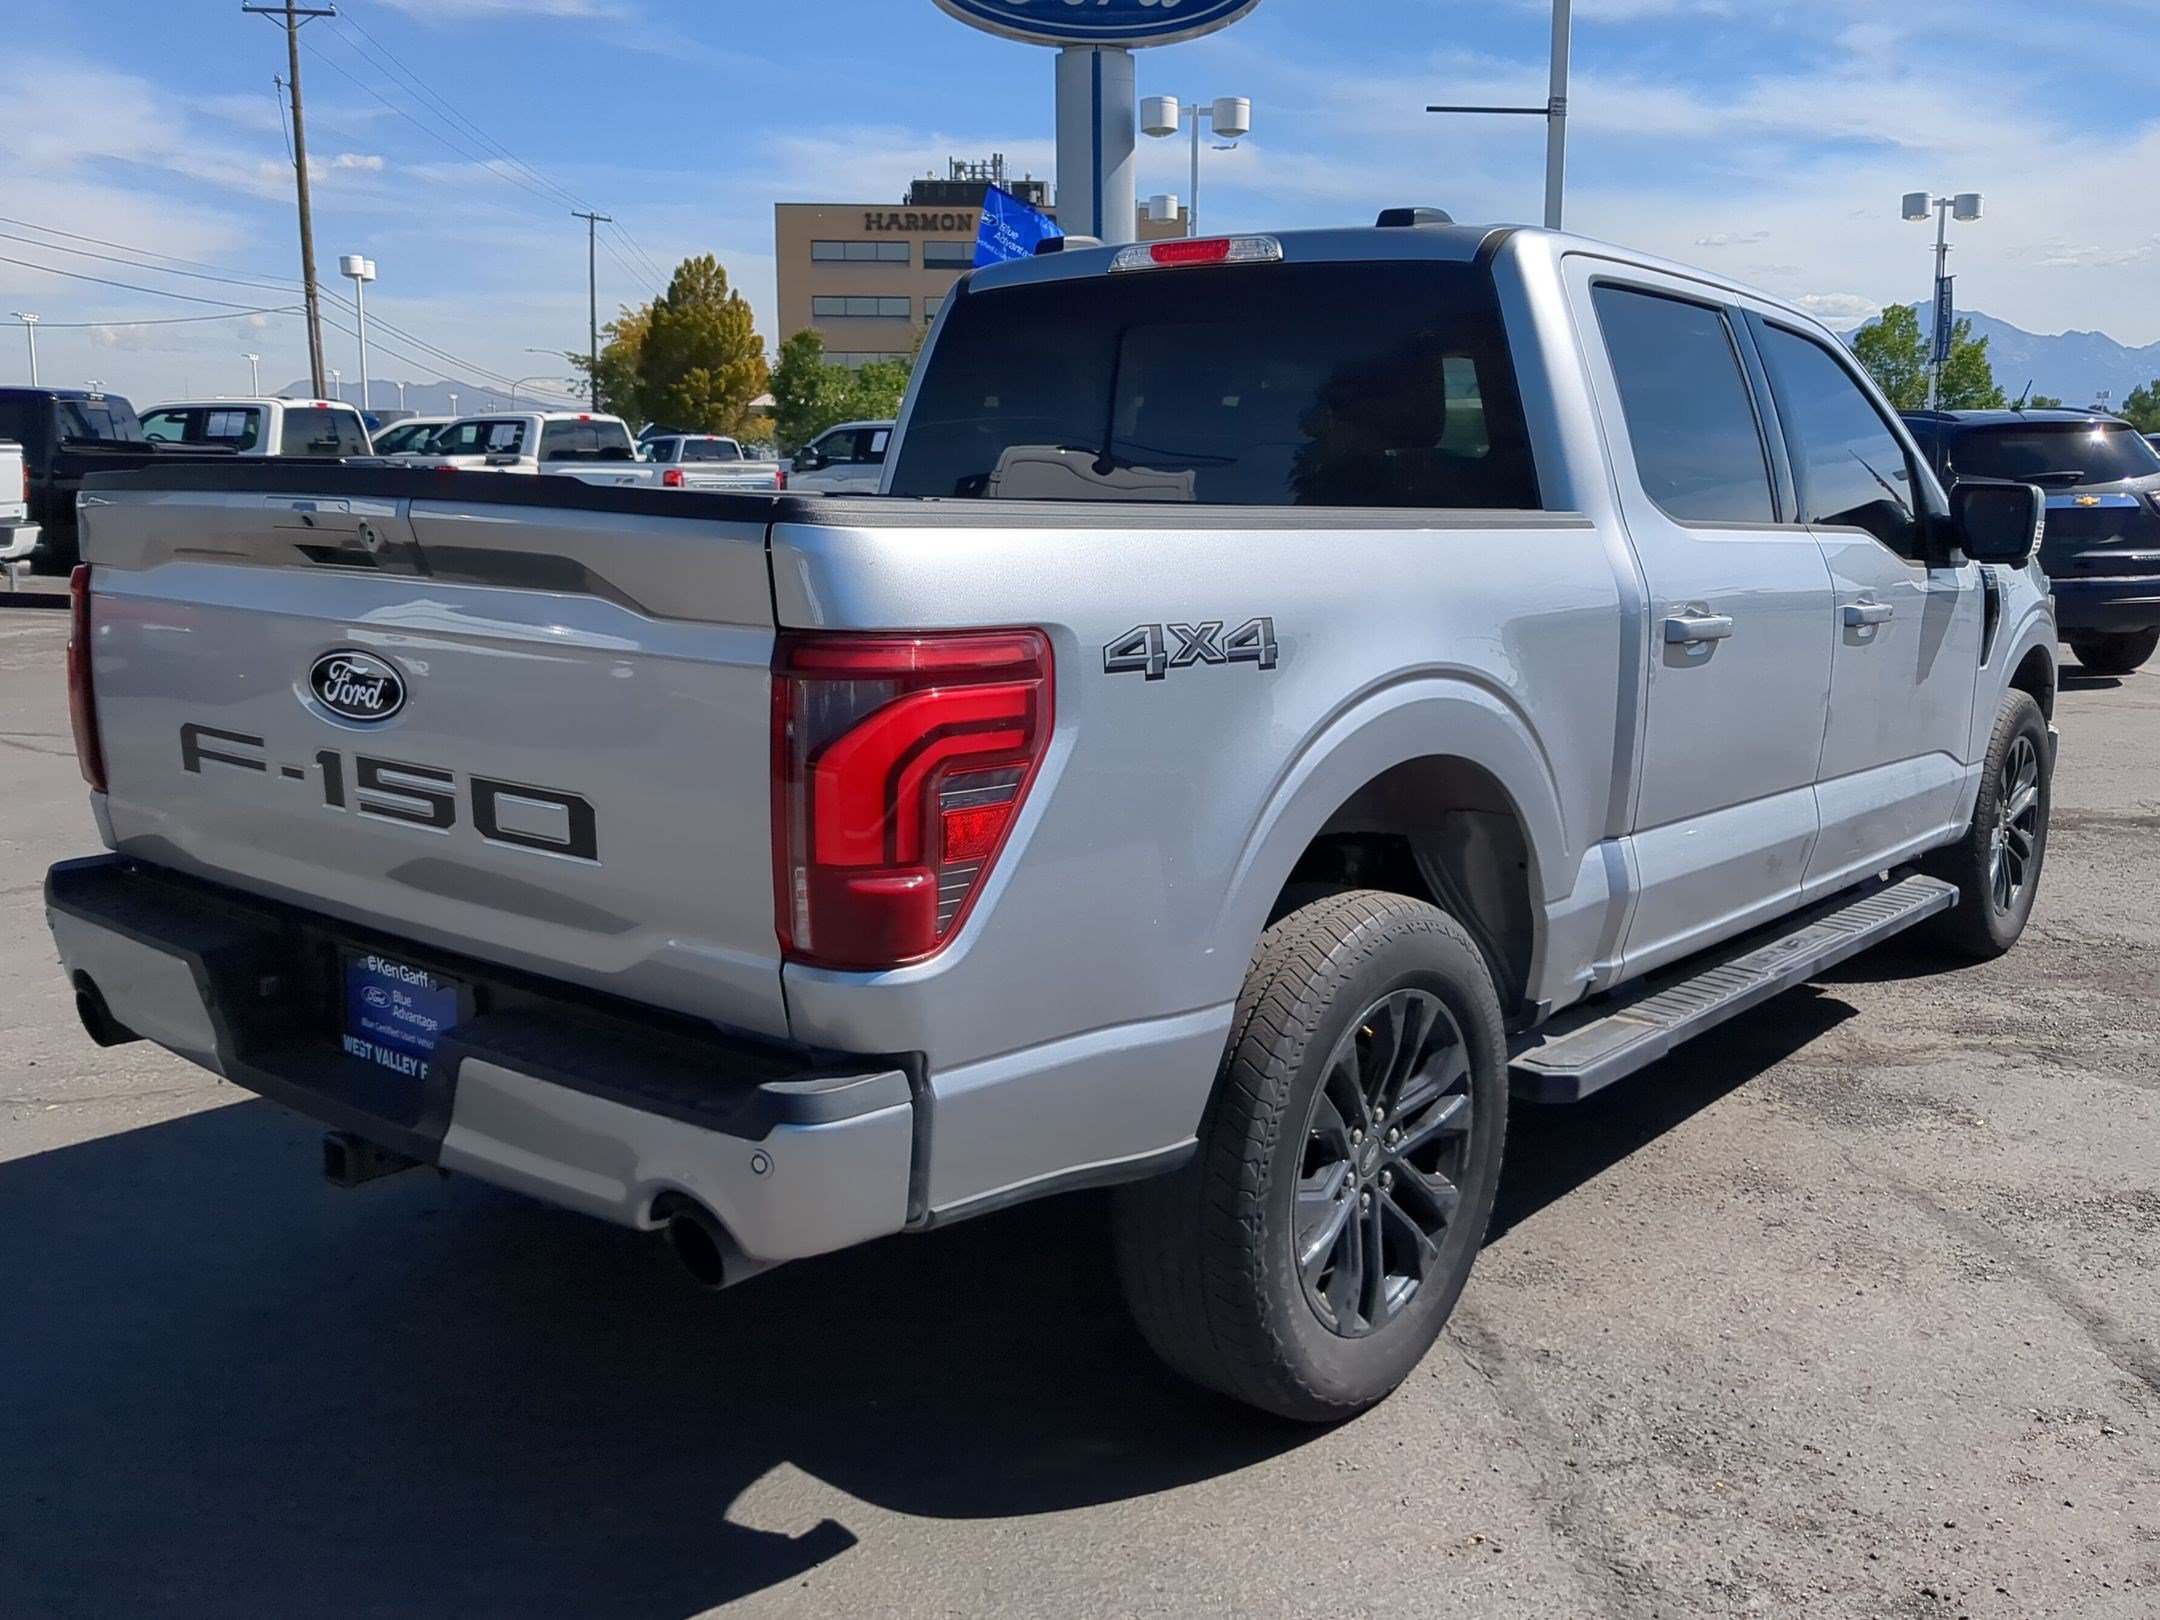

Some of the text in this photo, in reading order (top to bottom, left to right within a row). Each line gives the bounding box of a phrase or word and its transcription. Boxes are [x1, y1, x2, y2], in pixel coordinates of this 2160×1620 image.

[864, 212, 973, 232] HARMON
[999, 222, 1019, 240] Blue
[323, 659, 387, 711] Ford
[180, 722, 602, 866] F-150
[392, 990, 412, 1007] Blue
[392, 1005, 438, 1031] Advantage
[343, 1034, 372, 1059] WEST
[375, 1045, 417, 1077] VALLEY
